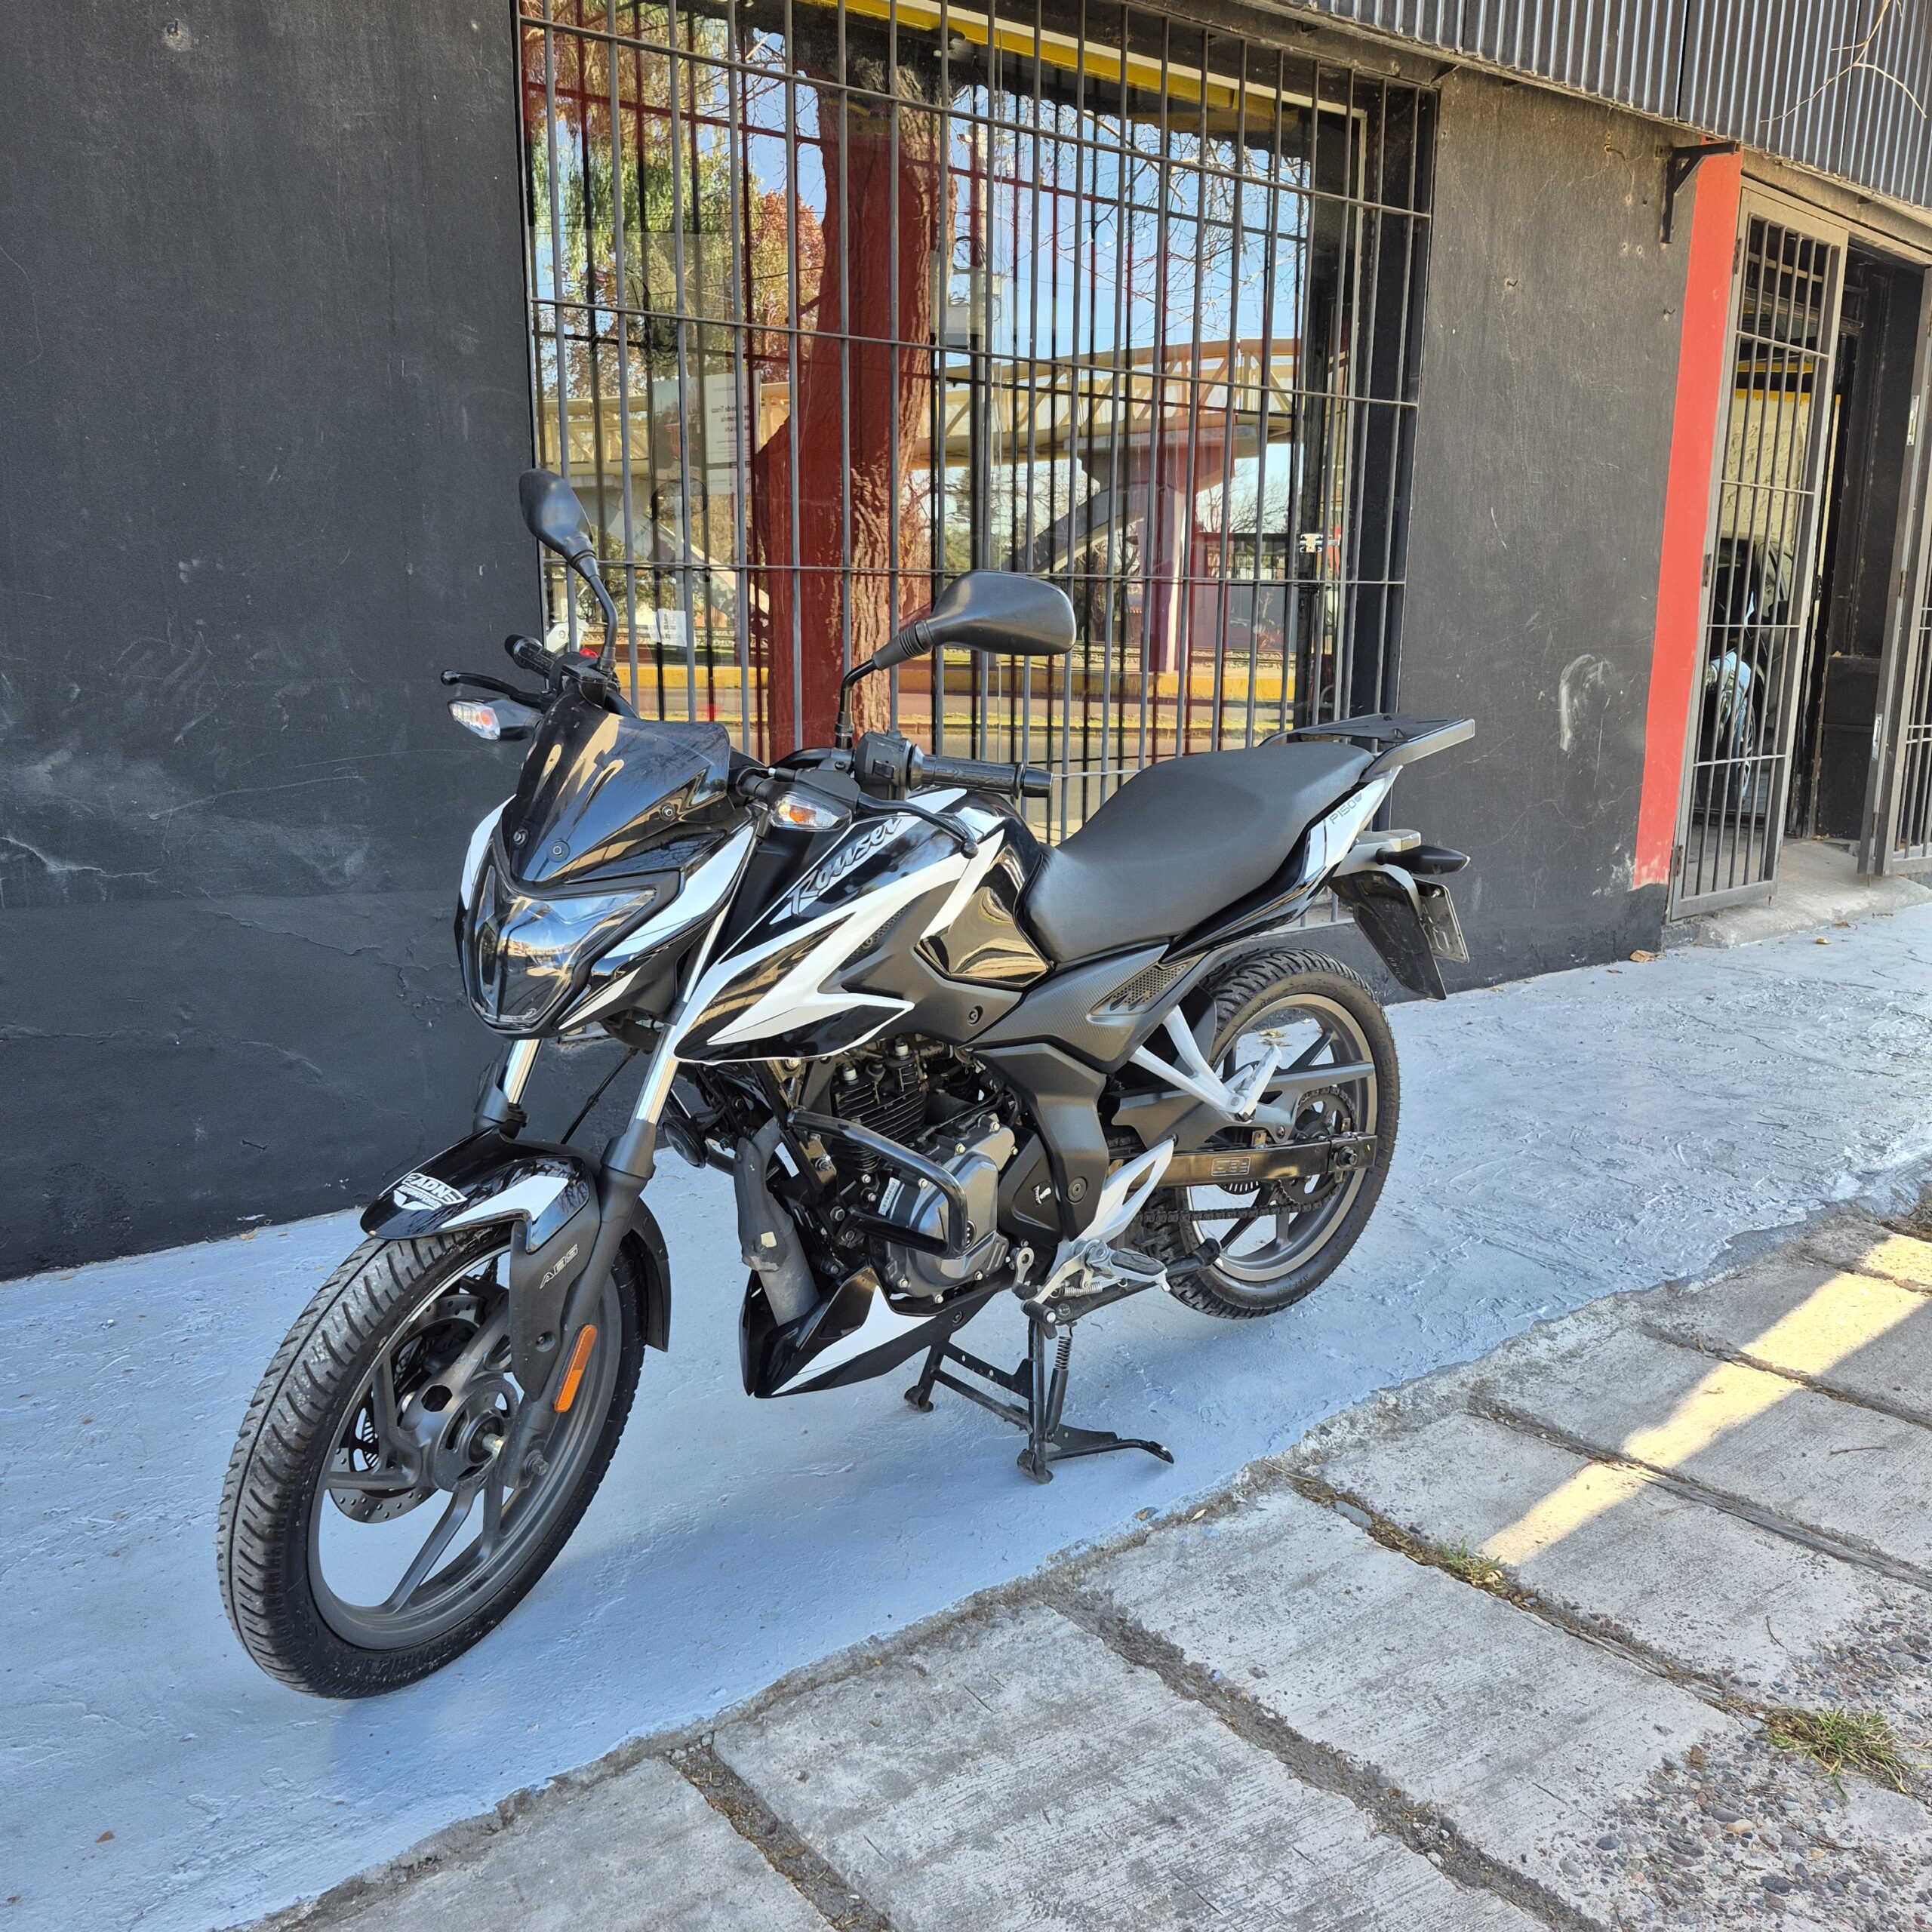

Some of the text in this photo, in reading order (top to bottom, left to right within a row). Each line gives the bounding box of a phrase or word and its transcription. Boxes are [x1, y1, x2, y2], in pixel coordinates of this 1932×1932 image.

[1329, 799, 1357, 824] P150
[787, 818, 901, 915] Rouser
[397, 1185, 441, 1209] AUTOMOTORES
[410, 1177, 451, 1198] ADN
[539, 1244, 578, 1289] ABS
